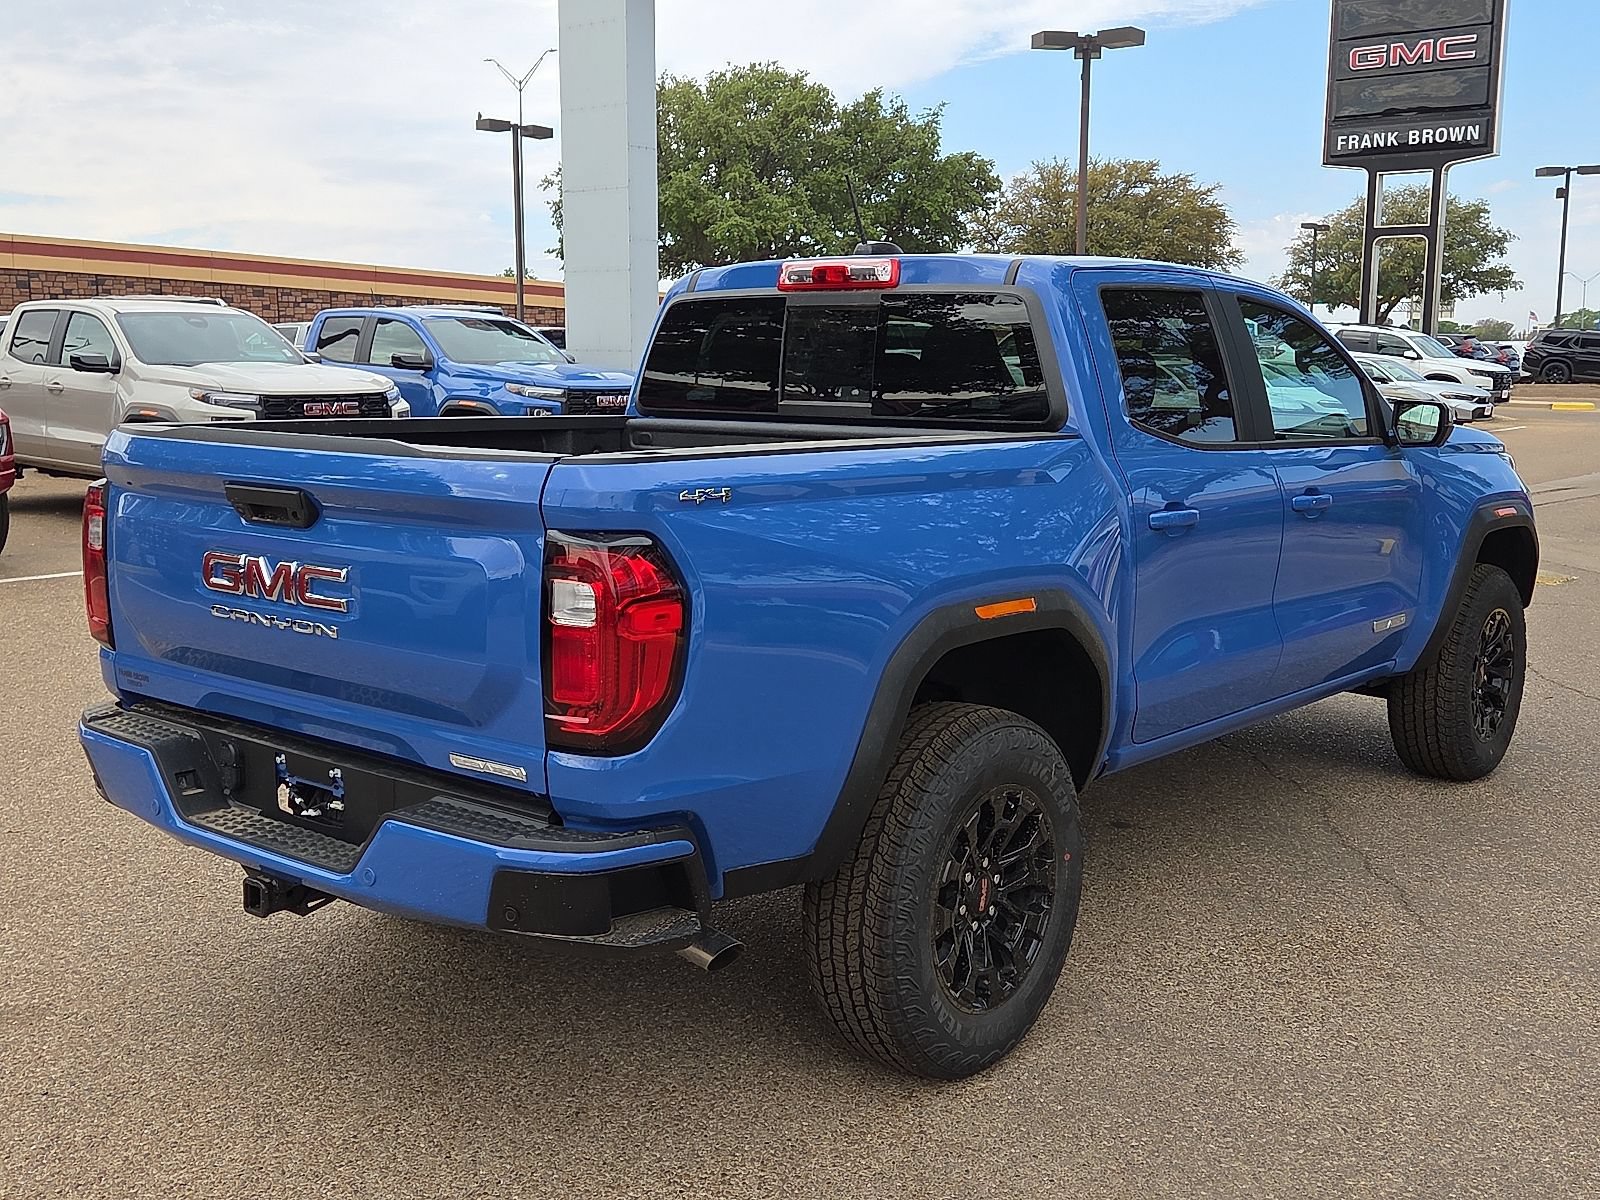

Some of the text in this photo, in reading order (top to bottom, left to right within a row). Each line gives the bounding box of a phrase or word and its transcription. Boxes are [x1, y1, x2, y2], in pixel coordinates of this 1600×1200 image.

[1350, 34, 1477, 70] GMC
[1337, 124, 1480, 151] FRANK BROWN
[303, 401, 360, 416] GMC
[596, 394, 630, 407] GM
[202, 550, 350, 613] GMC
[210, 604, 339, 639] CANYON
